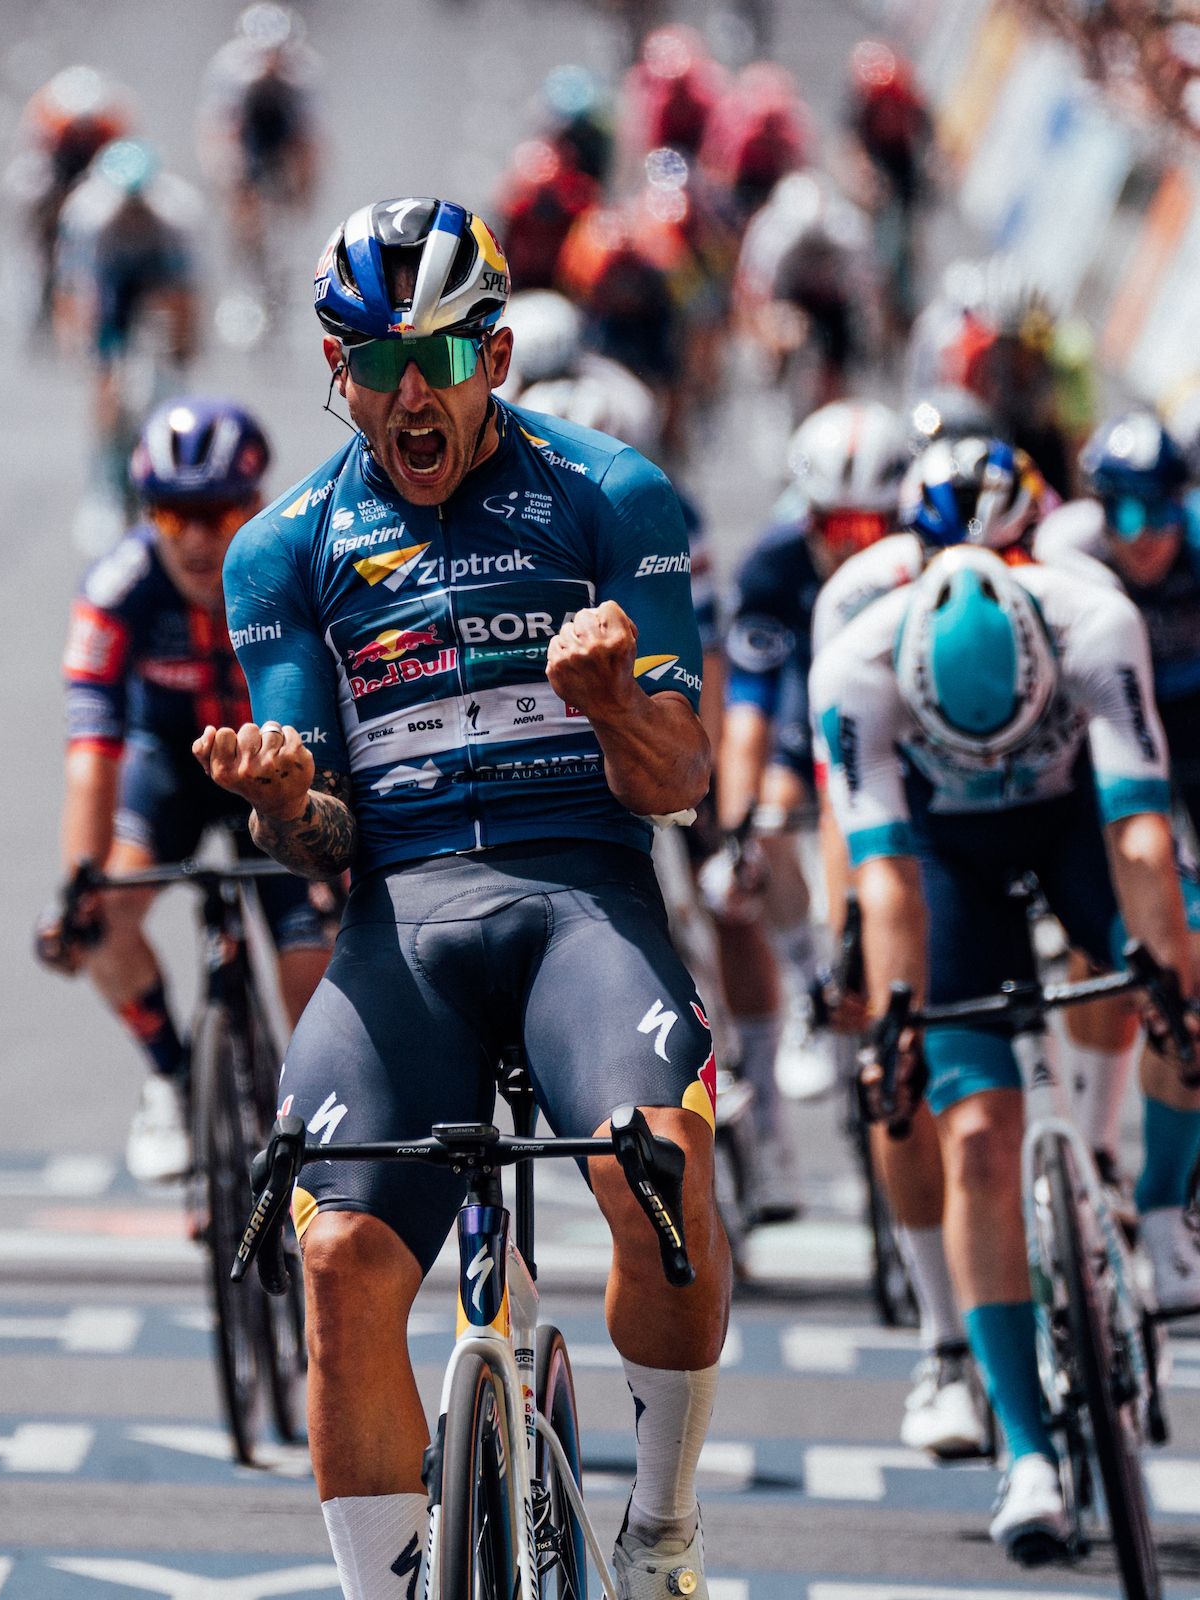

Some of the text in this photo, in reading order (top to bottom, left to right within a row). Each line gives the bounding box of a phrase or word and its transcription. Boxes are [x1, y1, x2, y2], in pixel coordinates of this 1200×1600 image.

[541, 448, 589, 476] Ziptrak
[524, 491, 553, 502] Santos
[357, 499, 377, 510] UCI
[359, 502, 393, 517] WORLD
[524, 506, 551, 517] down
[530, 500, 552, 509] tour
[361, 511, 388, 524] TOUR
[521, 512, 551, 525] under
[332, 522, 407, 562] Santini
[416, 549, 536, 587] Ziptrak
[400, 647, 457, 683] Bull
[407, 718, 444, 733] BOSS
[511, 763, 599, 780] AUSTRALIA
[511, 1144, 545, 1152] RAPIDE
[638, 1180, 682, 1249] SRAM
[238, 1190, 274, 1262] SRAM
